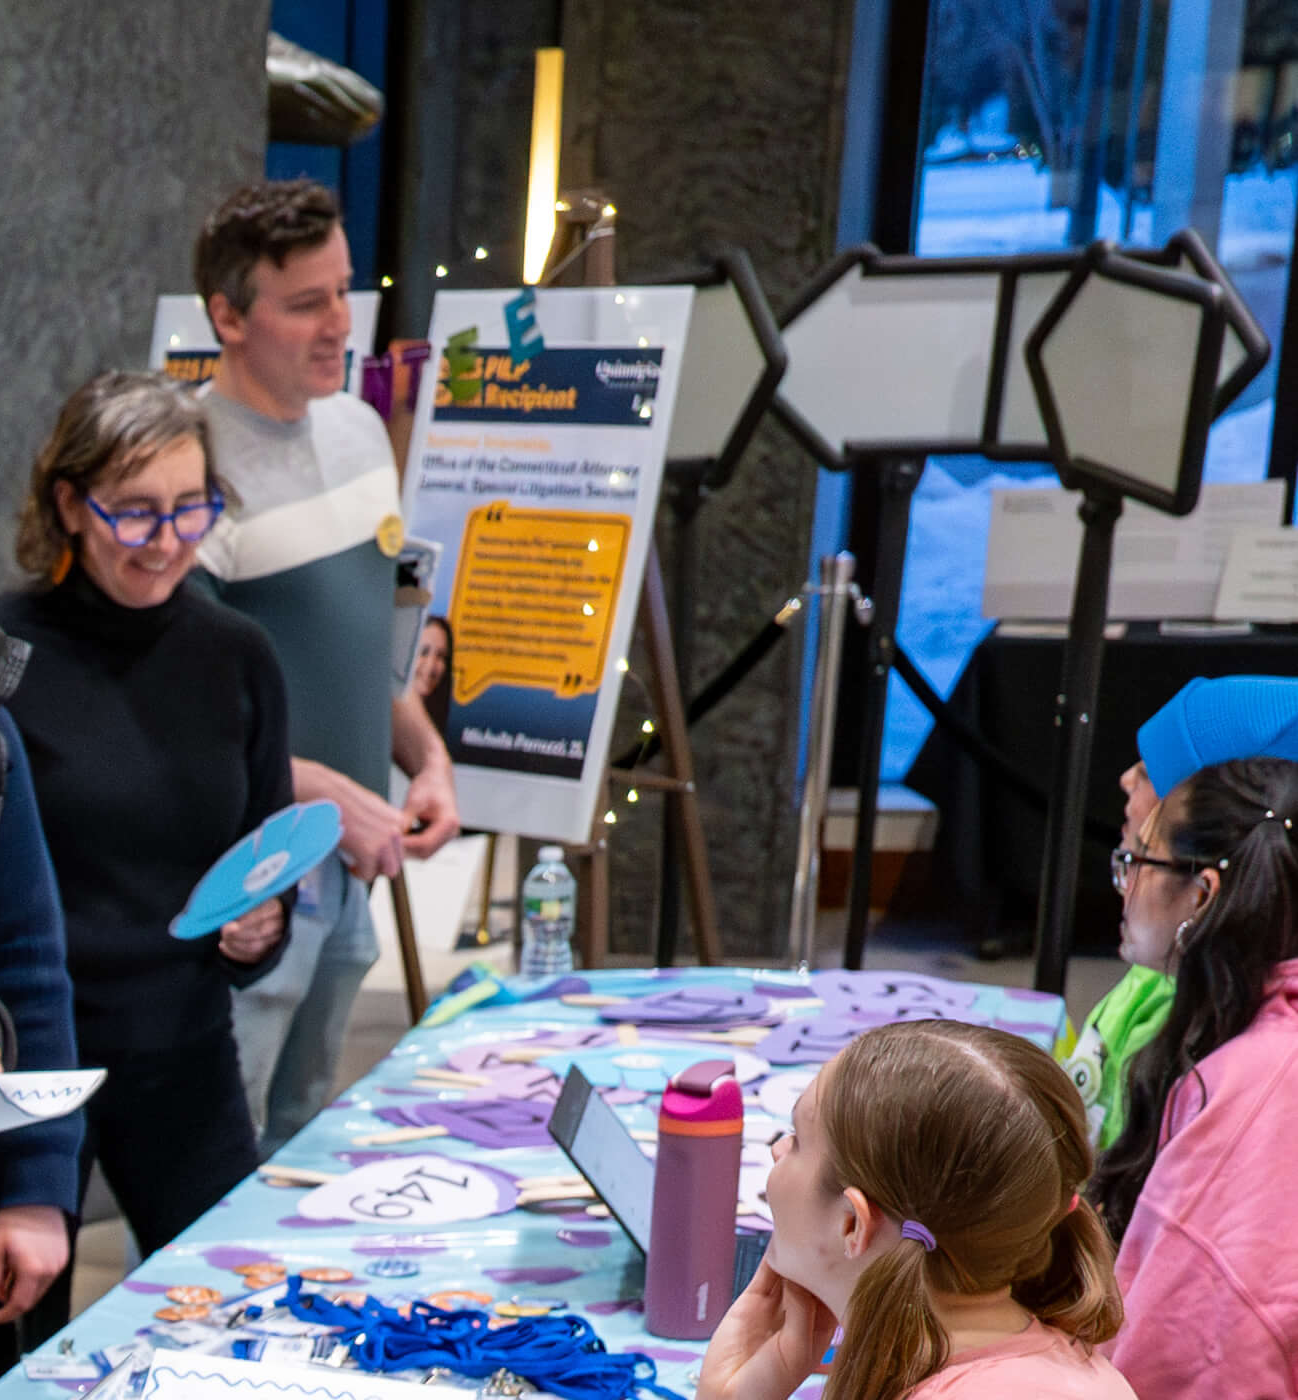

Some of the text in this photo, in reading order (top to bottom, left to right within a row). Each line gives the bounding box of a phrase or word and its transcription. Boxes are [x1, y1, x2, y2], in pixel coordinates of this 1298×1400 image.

[484, 384, 578, 412] Recipient
[459, 456, 475, 470] of
[476, 456, 496, 471] the
[498, 457, 578, 475] Connecticut
[519, 479, 583, 500] Litigation
[350, 1166, 468, 1218] 149
